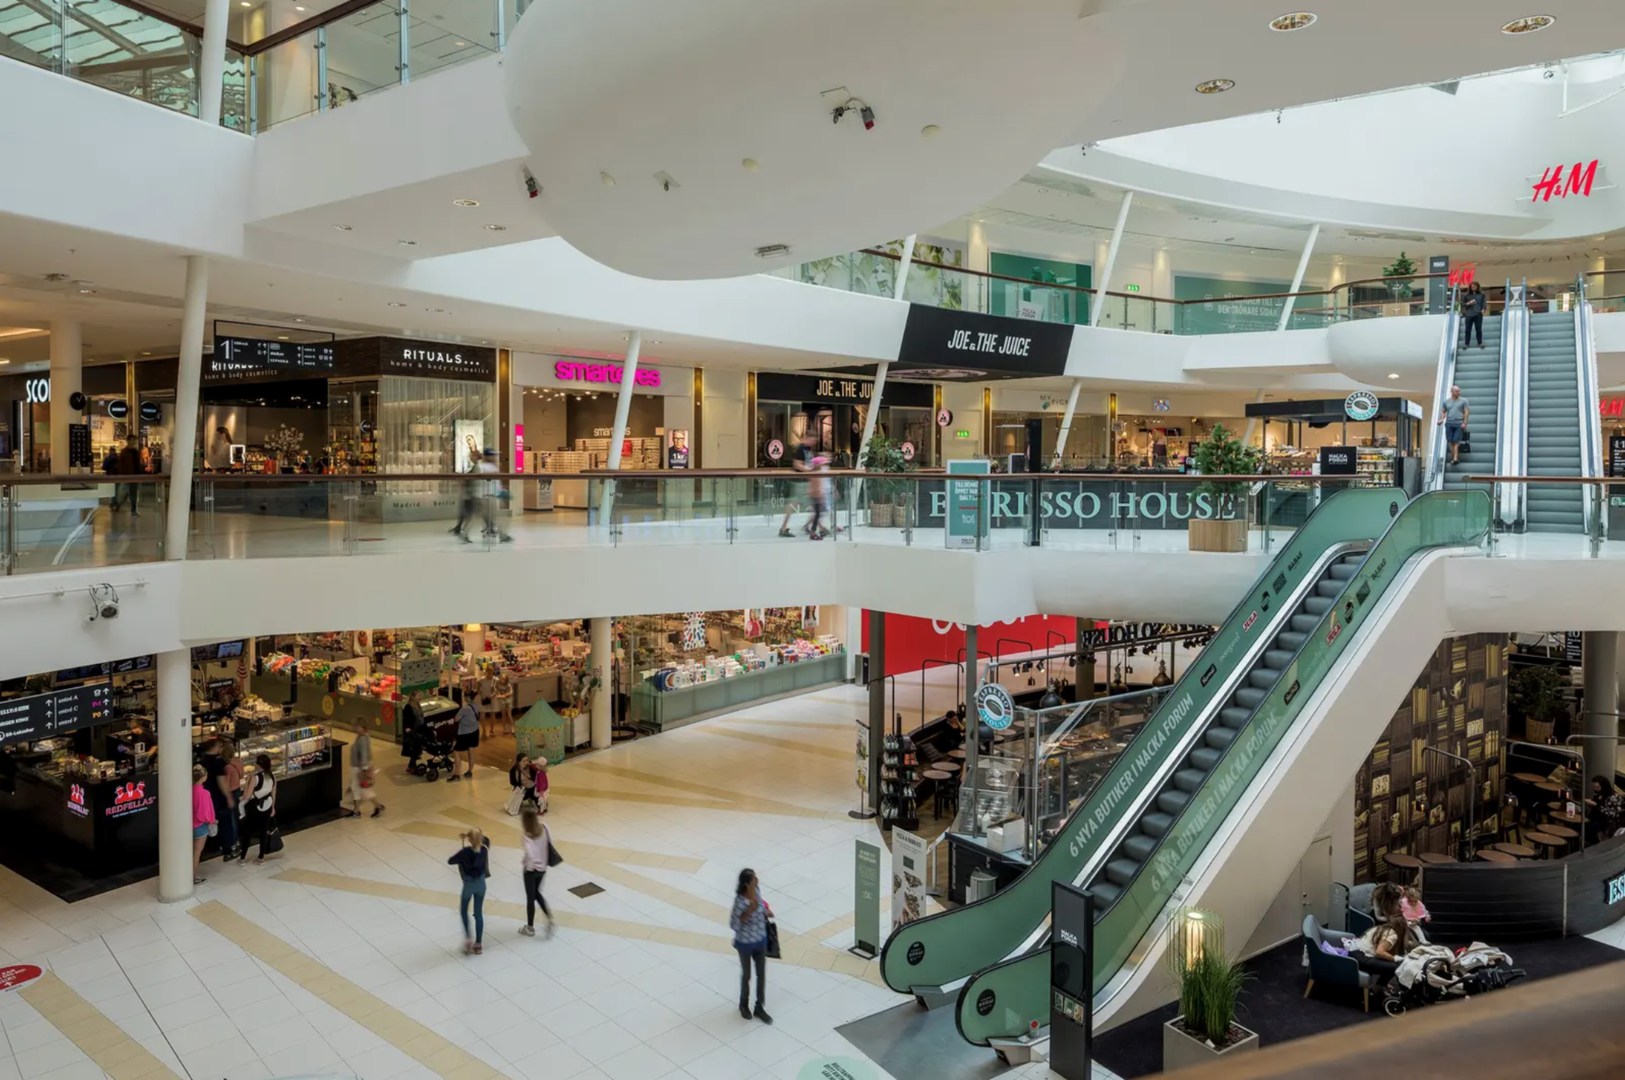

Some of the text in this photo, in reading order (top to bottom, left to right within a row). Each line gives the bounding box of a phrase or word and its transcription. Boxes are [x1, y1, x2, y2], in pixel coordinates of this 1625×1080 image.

[1532, 160, 1598, 202] H&M
[220, 339, 230, 360] 1
[948, 330, 970, 349] JOE
[975, 332, 998, 352] THE
[999, 336, 1031, 357] JUICE
[390, 360, 413, 368] home
[427, 363, 447, 371] body
[449, 366, 489, 374] cosmetics
[26, 378, 50, 402] SCO
[816, 380, 834, 397] JOE
[840, 381, 857, 399] THE
[859, 383, 884, 401] JUI
[593, 427, 631, 437] smarts
[1243, 610, 1258, 633] JULA
[1069, 693, 1194, 857] 6 NYA BUTIKER I NACKA FORUM
[105, 797, 154, 816] REDFELLAS
[1150, 874, 1160, 892] 6
[1176, 797, 1216, 852] BUTIKER
[1219, 752, 1250, 795] NACKA
[1246, 712, 1280, 758] FORUM
